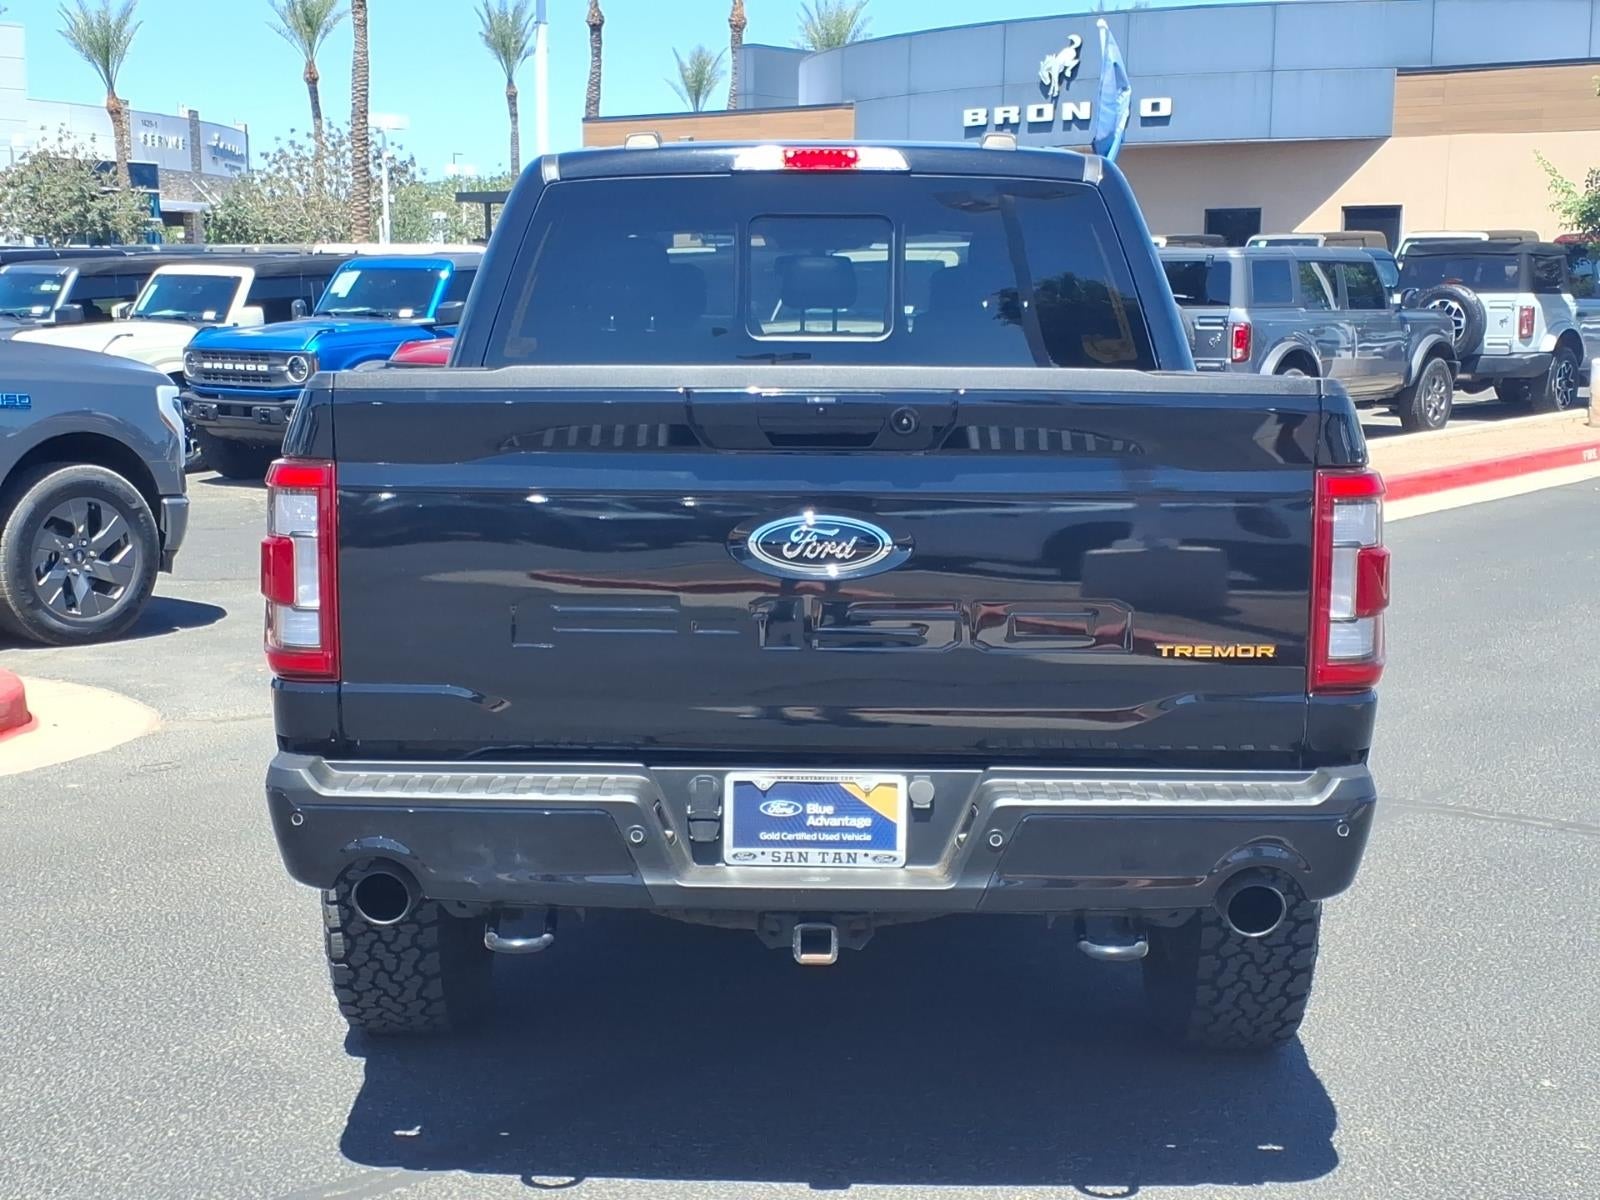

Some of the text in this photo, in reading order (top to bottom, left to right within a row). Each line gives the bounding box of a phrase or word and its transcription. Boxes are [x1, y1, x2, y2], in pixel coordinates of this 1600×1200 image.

[963, 97, 1172, 126] BRONO
[140, 131, 186, 150] SERVICE
[203, 362, 268, 371] BRONCO
[783, 526, 859, 560] Ford
[1156, 643, 1276, 658] TREMOR
[806, 803, 834, 815] Blue
[806, 816, 872, 828] Advantage
[759, 831, 872, 841] Gold Certified Used Vehicle
[771, 851, 809, 863] SAN
[818, 852, 858, 864] TAN
